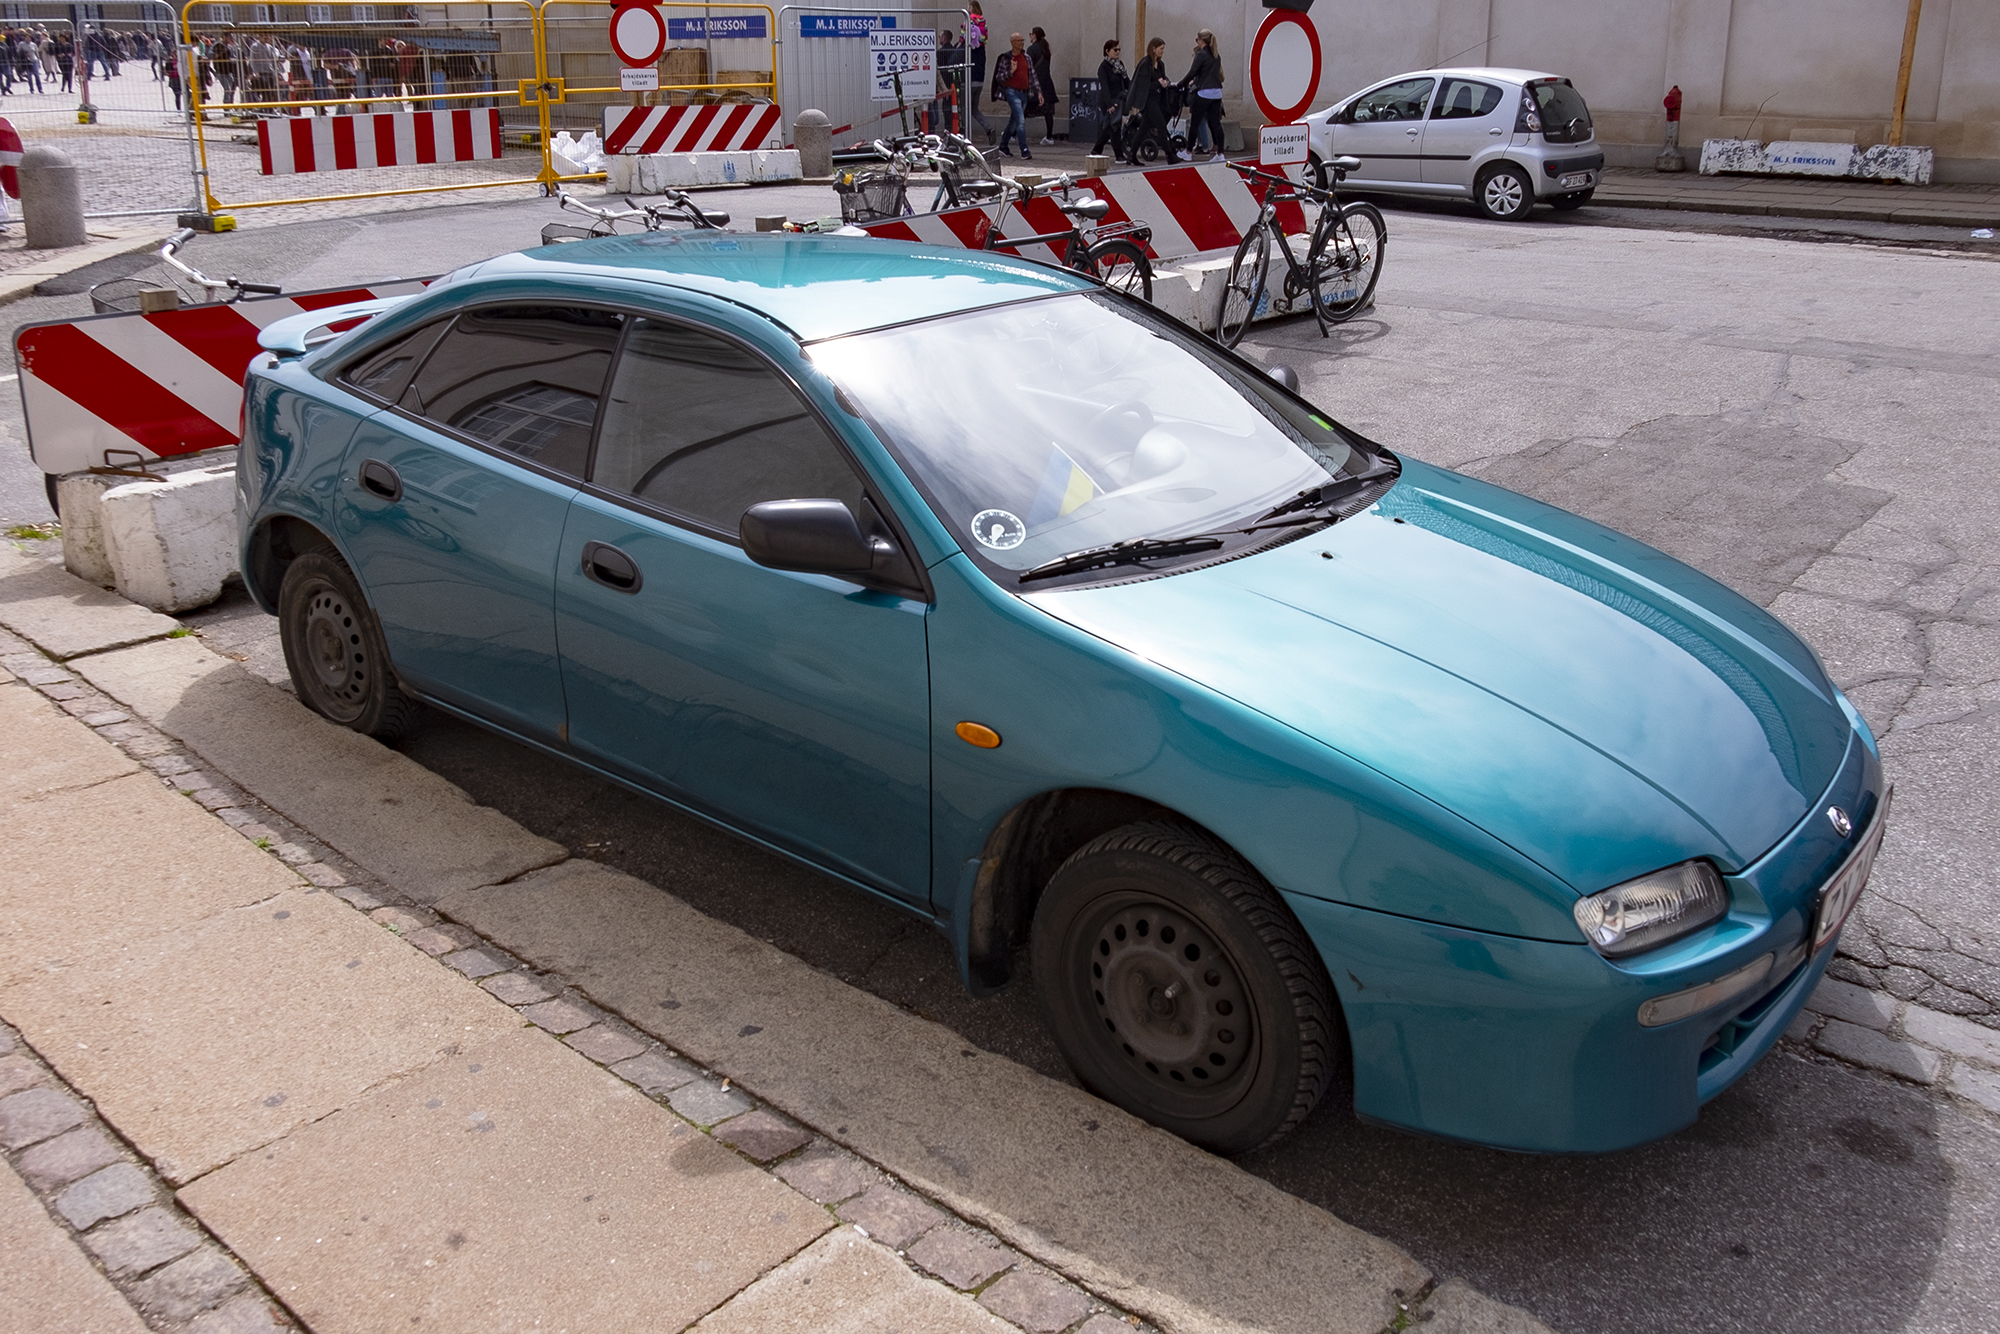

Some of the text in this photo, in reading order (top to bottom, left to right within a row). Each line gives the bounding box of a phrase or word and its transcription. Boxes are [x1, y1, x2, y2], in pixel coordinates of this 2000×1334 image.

[1262, 133, 1307, 145] Arbejdskørsel
[1274, 146, 1294, 155] tilladt
[1792, 156, 1836, 165] ERIKSSON
